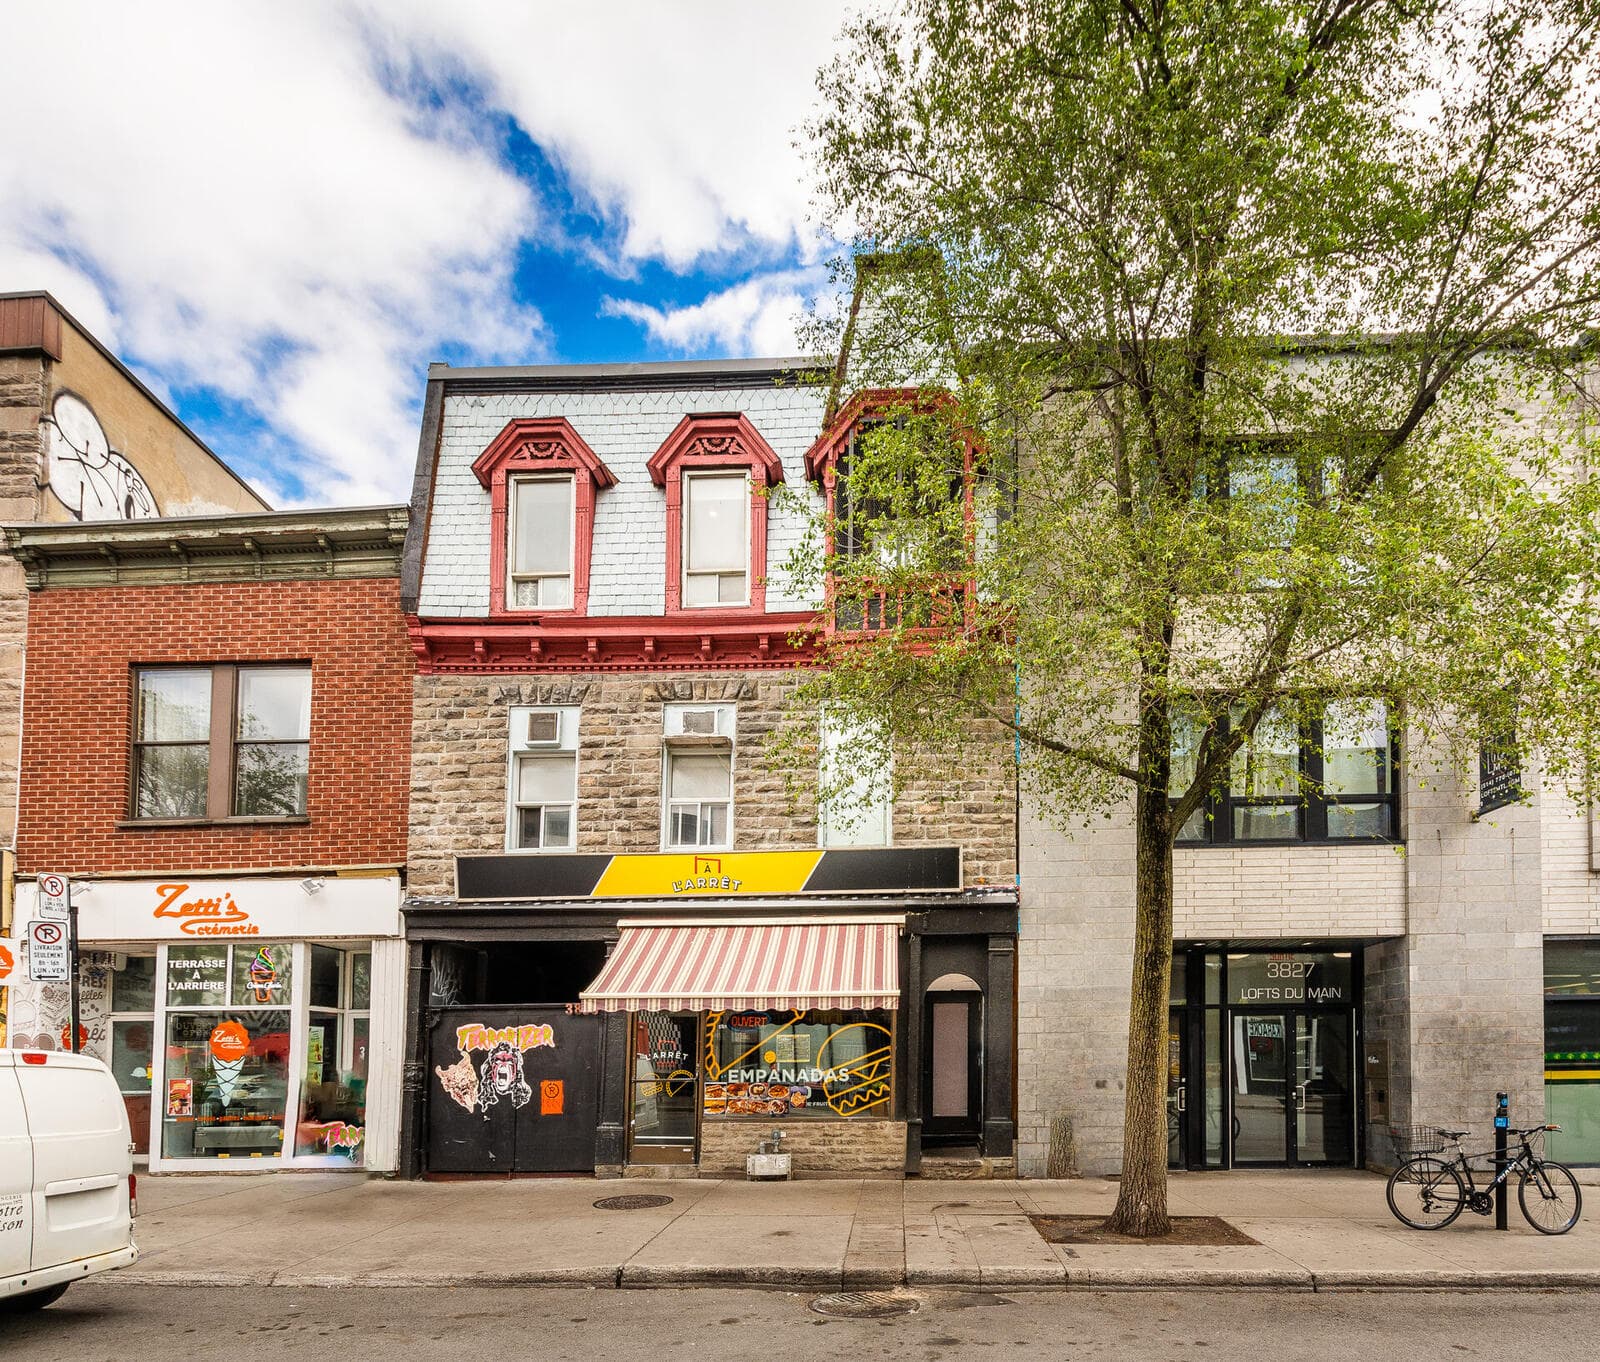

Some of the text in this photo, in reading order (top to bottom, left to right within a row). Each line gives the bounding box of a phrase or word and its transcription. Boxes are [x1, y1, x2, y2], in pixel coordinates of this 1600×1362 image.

[704, 862, 711, 873] À
[672, 876, 742, 893] L'ARRÊT
[153, 884, 249, 918] Zetti's
[168, 959, 226, 969] TERRASSE
[1267, 962, 1315, 978] 3827
[192, 969, 201, 979] À
[168, 980, 225, 990] L'ARRIÈRE
[1241, 986, 1341, 999] LOFTS DU MAIN
[730, 1015, 768, 1028] OUVERT
[456, 1024, 555, 1052] TERRORIZER
[728, 1068, 850, 1083] EMPANADAS
